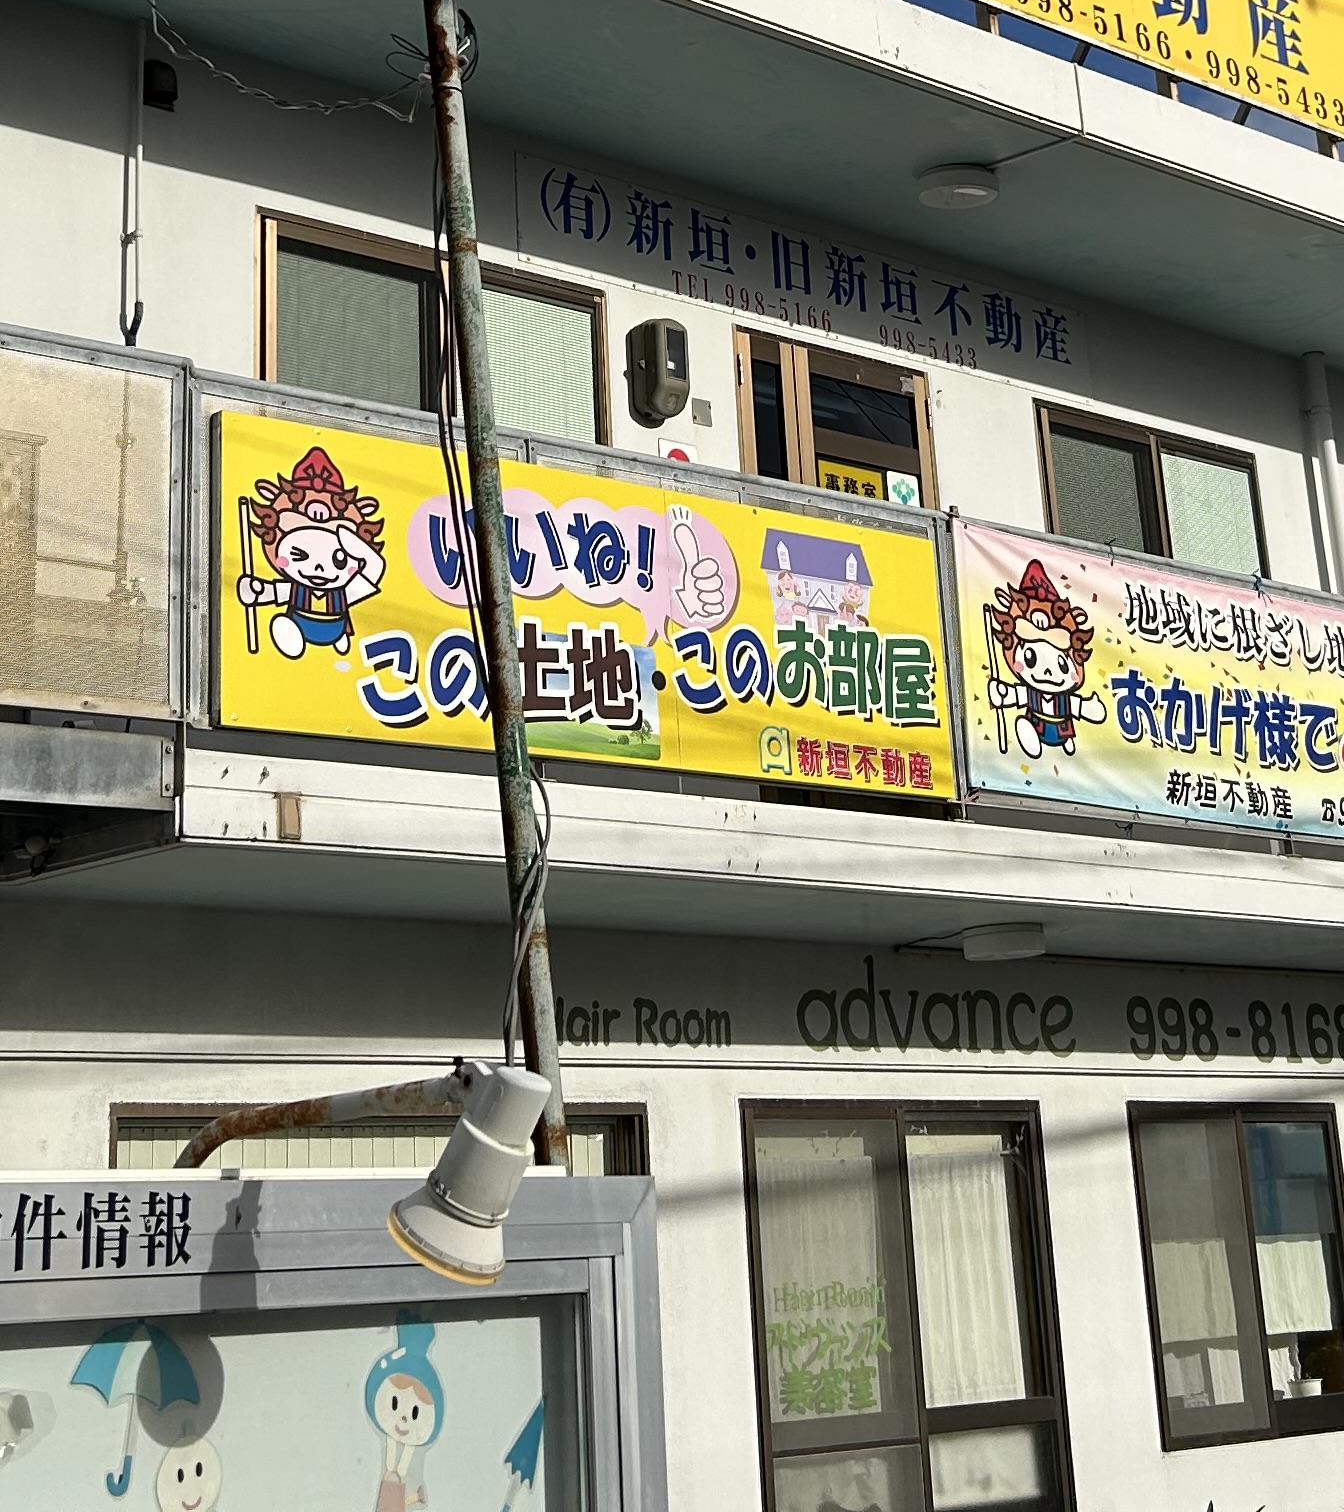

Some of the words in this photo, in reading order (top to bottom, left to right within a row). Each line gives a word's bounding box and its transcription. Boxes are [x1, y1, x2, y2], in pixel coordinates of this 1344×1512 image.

[671, 270, 715, 303] TEL
[724, 283, 832, 332] 998-5166
[878, 324, 977, 369] 998-5433
[797, 736, 933, 790] 新垣不動産
[1166, 769, 1294, 820] 新垣不動産
[633, 997, 732, 1048] Room
[796, 954, 1077, 1057] advance
